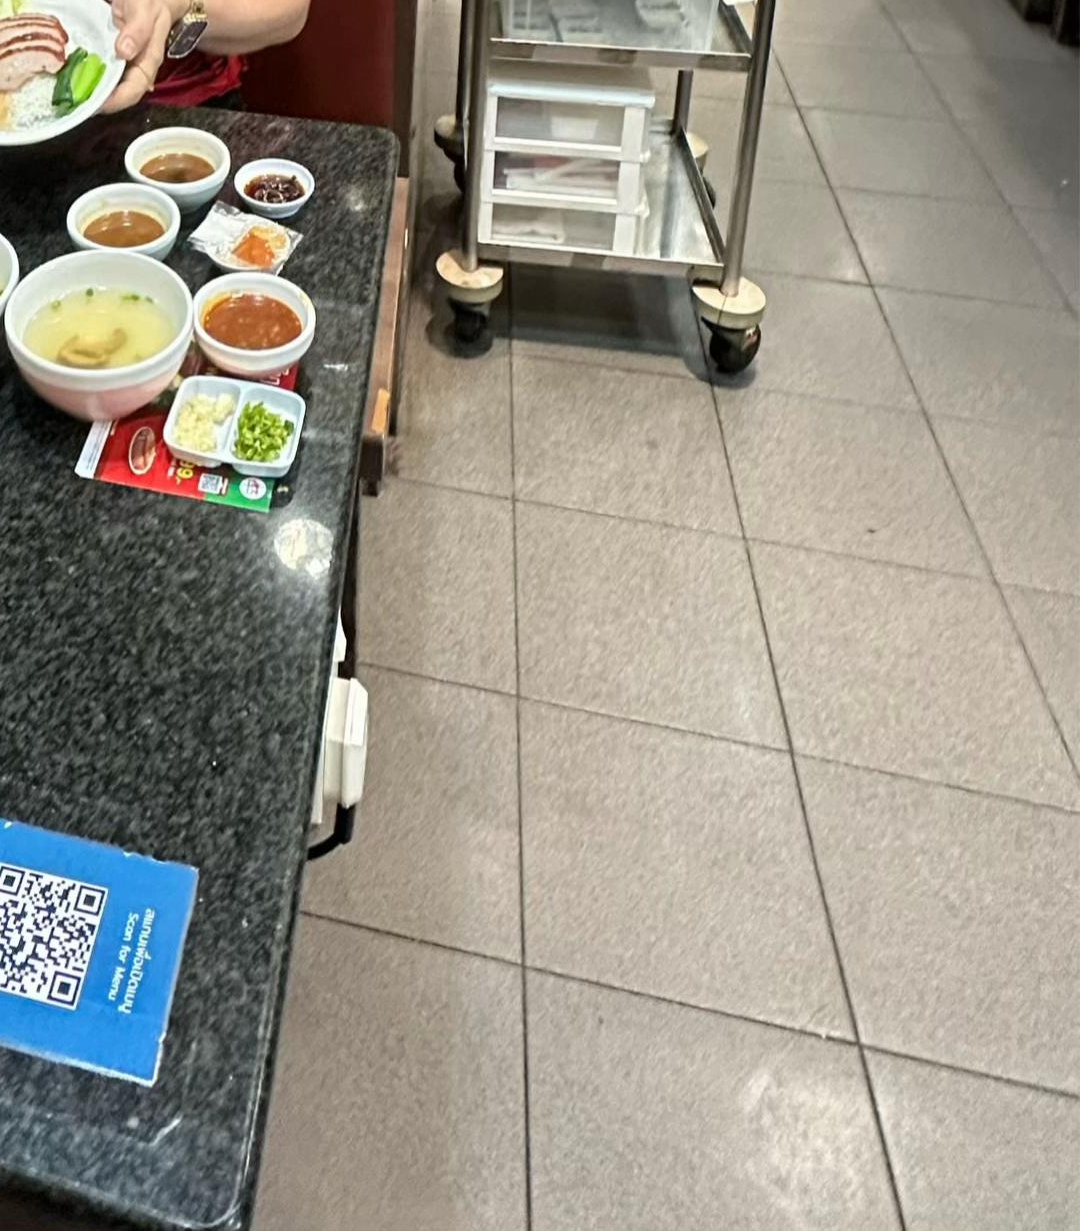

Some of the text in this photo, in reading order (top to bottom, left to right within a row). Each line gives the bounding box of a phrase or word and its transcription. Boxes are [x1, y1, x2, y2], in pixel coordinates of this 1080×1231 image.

[107, 912, 140, 1002] Scan for Menu
[118, 907, 156, 1015] สแกนเพื่อเปิดเมนู
